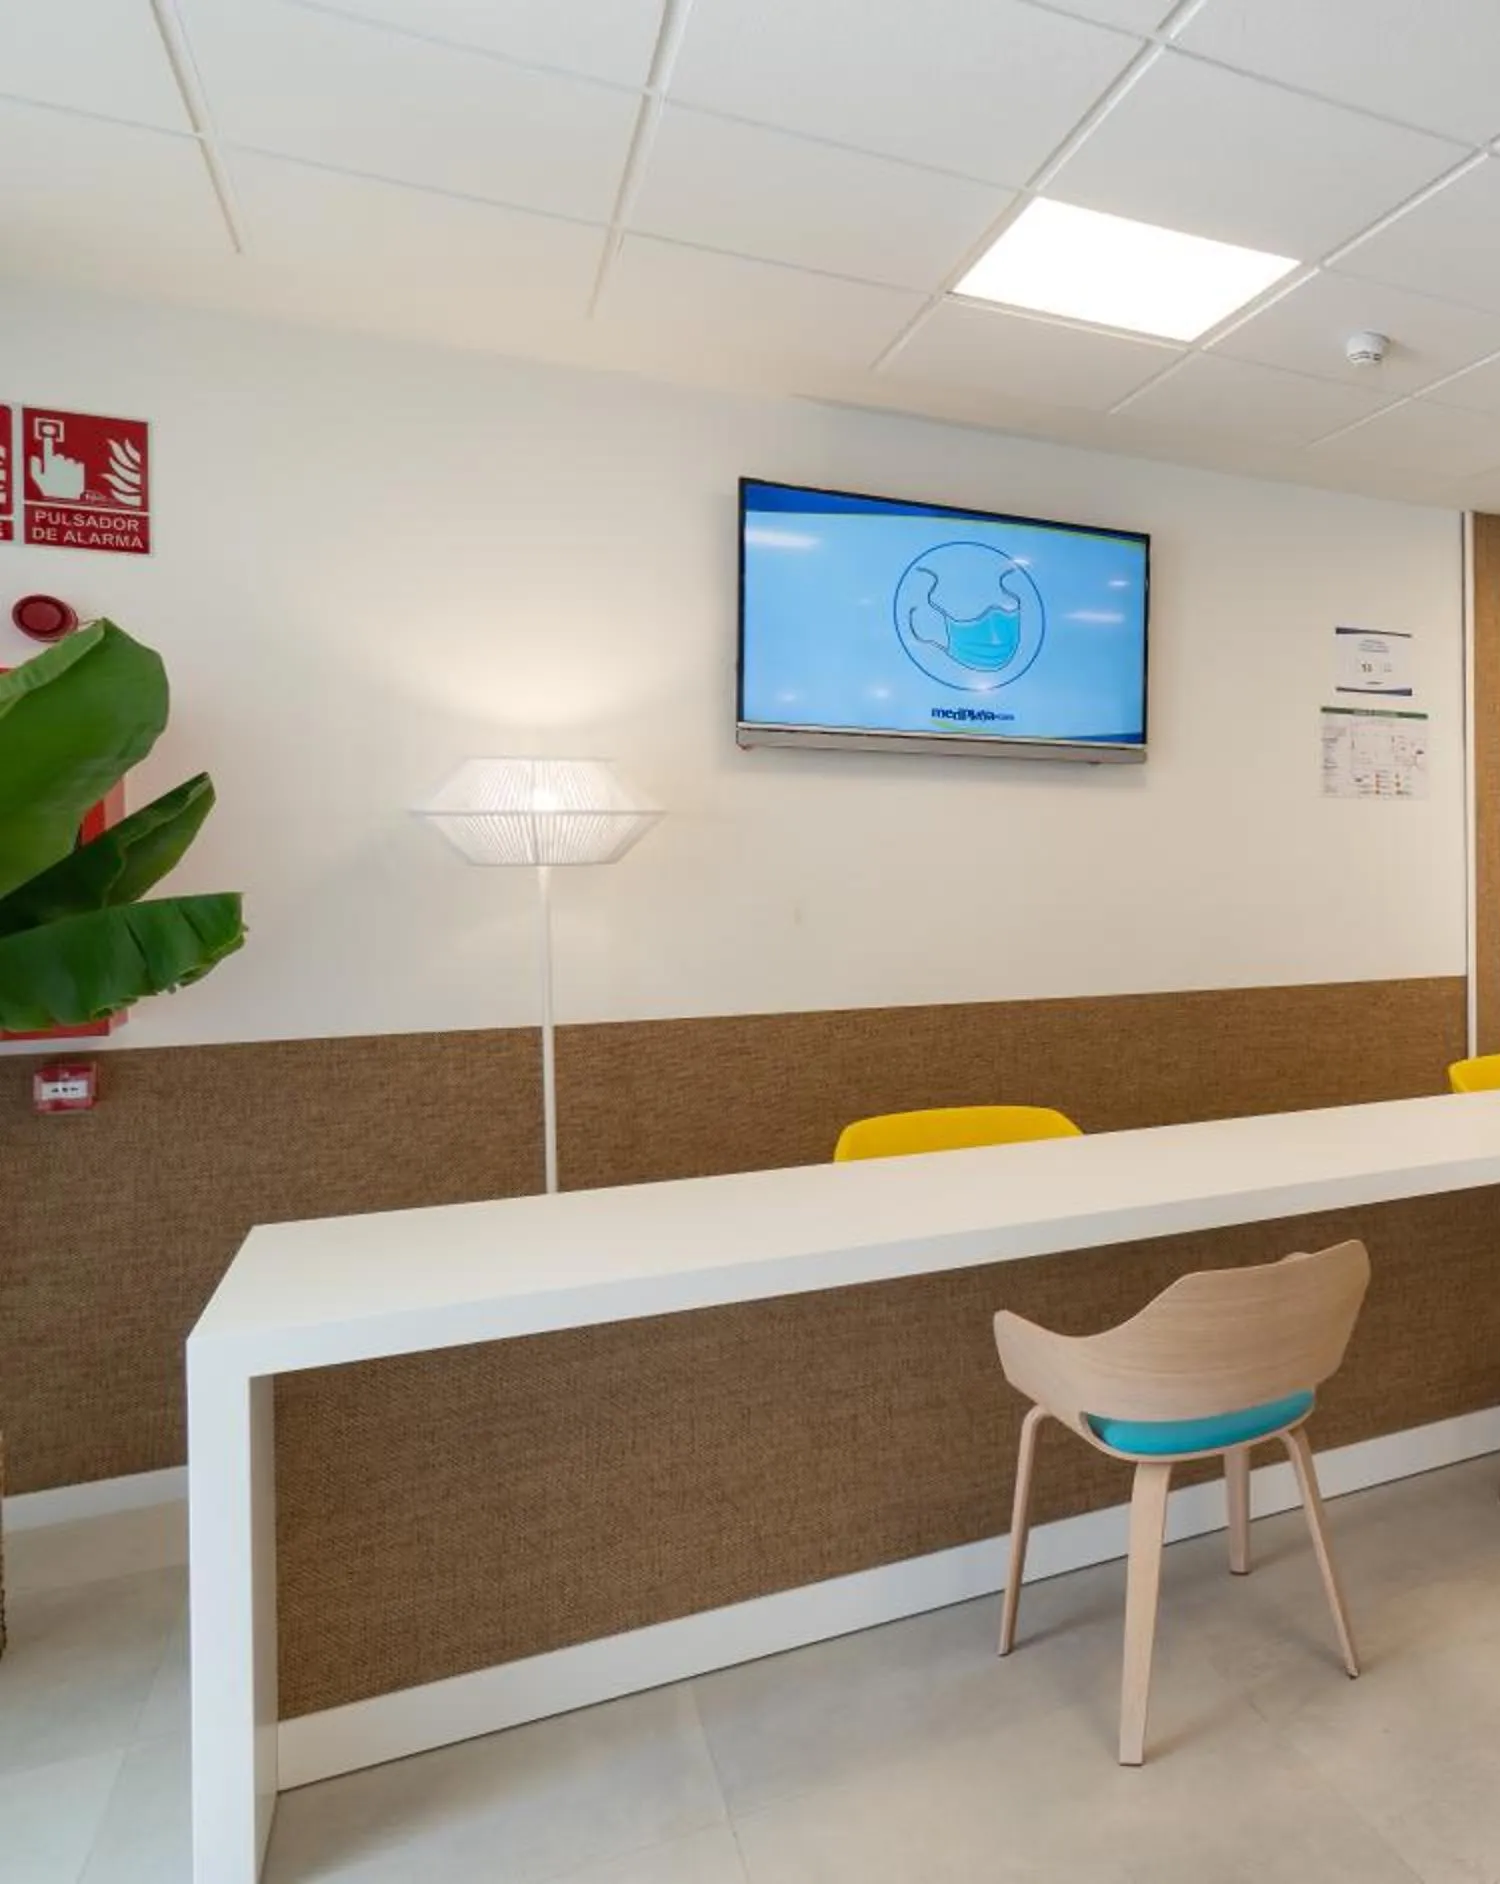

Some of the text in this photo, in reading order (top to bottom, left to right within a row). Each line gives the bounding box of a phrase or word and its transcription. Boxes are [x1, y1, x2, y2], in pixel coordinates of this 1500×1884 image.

[34, 509, 140, 532] PULSADOR
[31, 526, 144, 548] DE ALARMA
